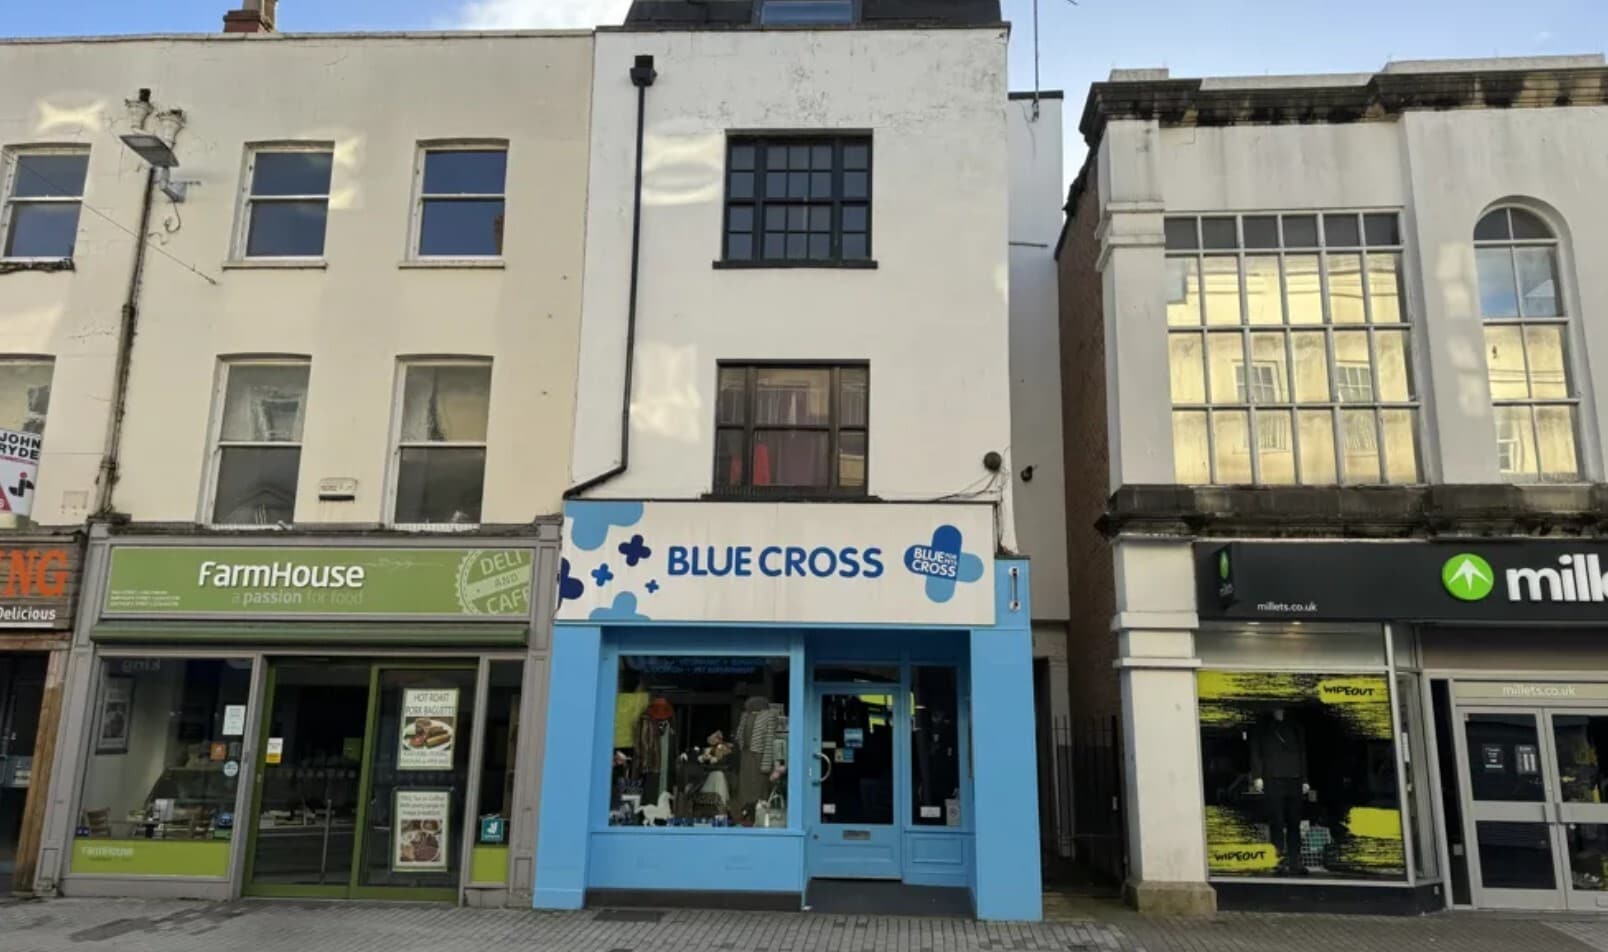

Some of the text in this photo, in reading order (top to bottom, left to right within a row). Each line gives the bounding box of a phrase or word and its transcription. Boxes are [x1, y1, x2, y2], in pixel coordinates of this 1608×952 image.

[0, 433, 41, 449] JOHN
[0, 443, 39, 460] RYDE
[480, 551, 521, 575] DELI
[667, 546, 884, 578] BLUE CROSS
[913, 547, 945, 563] BLUE
[0, 548, 70, 597] NG
[198, 561, 365, 588] FarmHouse
[911, 559, 956, 577] CROSS
[1506, 553, 1608, 602] mill
[243, 590, 302, 606] passion
[307, 590, 328, 604] for
[331, 590, 364, 605] food
[1257, 602, 1317, 613] millets.co.uk
[1322, 684, 1375, 698] WIPEOUT
[1503, 685, 1576, 698] millets.co.uk
[1215, 849, 1267, 862] WIPEOUT
